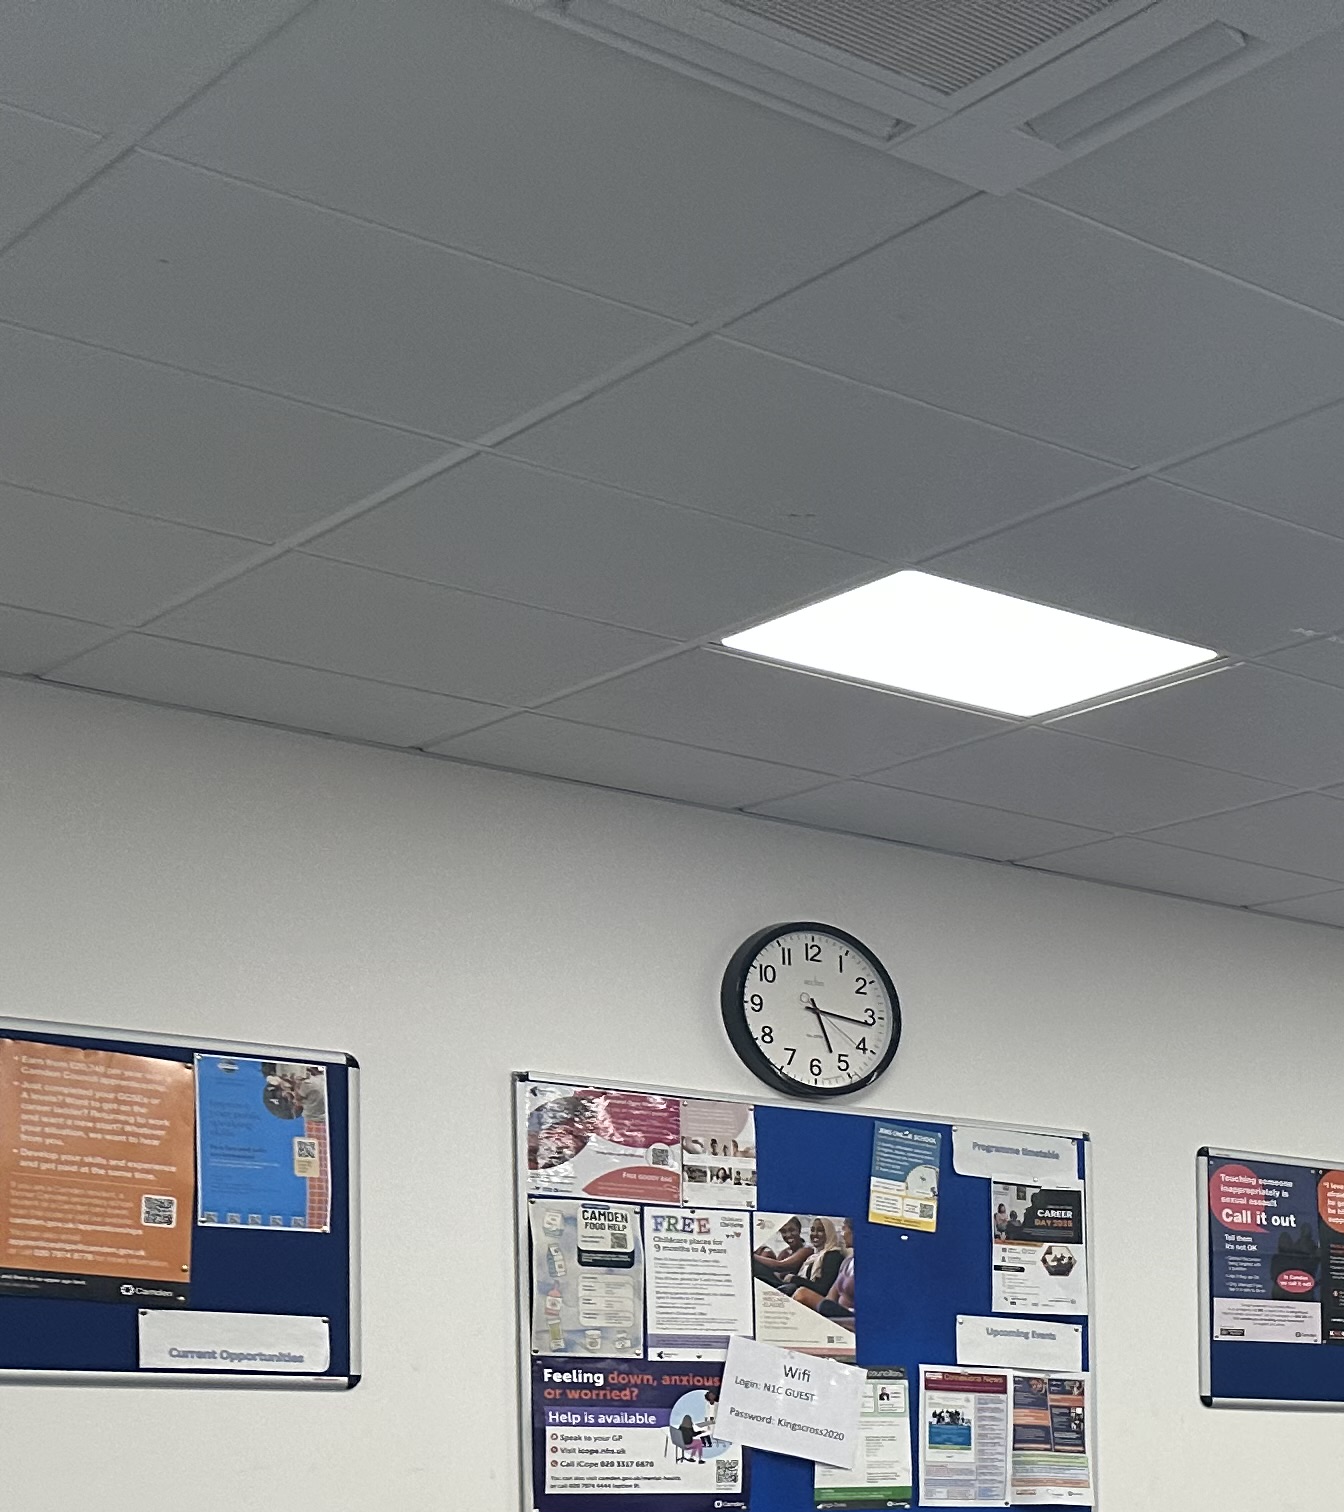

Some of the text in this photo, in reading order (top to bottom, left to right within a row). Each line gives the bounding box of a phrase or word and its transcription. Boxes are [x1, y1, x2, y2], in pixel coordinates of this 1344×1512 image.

[782, 947, 792, 966] 11
[805, 943, 822, 962] 12
[760, 964, 776, 983] 10
[855, 977, 867, 995] 2
[750, 994, 763, 1012] 9
[864, 1008, 876, 1026] 3
[762, 1026, 774, 1044] 8
[856, 1037, 868, 1054] 4
[784, 1048, 796, 1065] 7
[838, 1054, 849, 1071] 5
[810, 1058, 822, 1076] 6
[973, 1142, 1060, 1160] Programme timetable
[1220, 1173, 1293, 1187] Touching someone
[1221, 1185, 1280, 1198] inappropriately
[582, 1210, 628, 1223] CAMDEN
[1037, 1209, 1072, 1218] CAREER
[1222, 1208, 1296, 1228] Call it out
[585, 1222, 627, 1231] FOOD HELP
[652, 1215, 711, 1234] FREE
[653, 1236, 687, 1244] Childcare
[654, 1244, 660, 1252] 9
[986, 1327, 1056, 1340] Upcoming Events
[169, 1347, 304, 1363] Current Opportunities
[544, 1369, 720, 1386] Feeling down, anxious
[784, 1364, 811, 1382] Wifi
[544, 1387, 638, 1400] or worried?
[735, 1376, 815, 1402] Login: N1C GUEST
[548, 1411, 656, 1425] Help is available
[730, 1407, 845, 1440] Password: Kingscross2020
